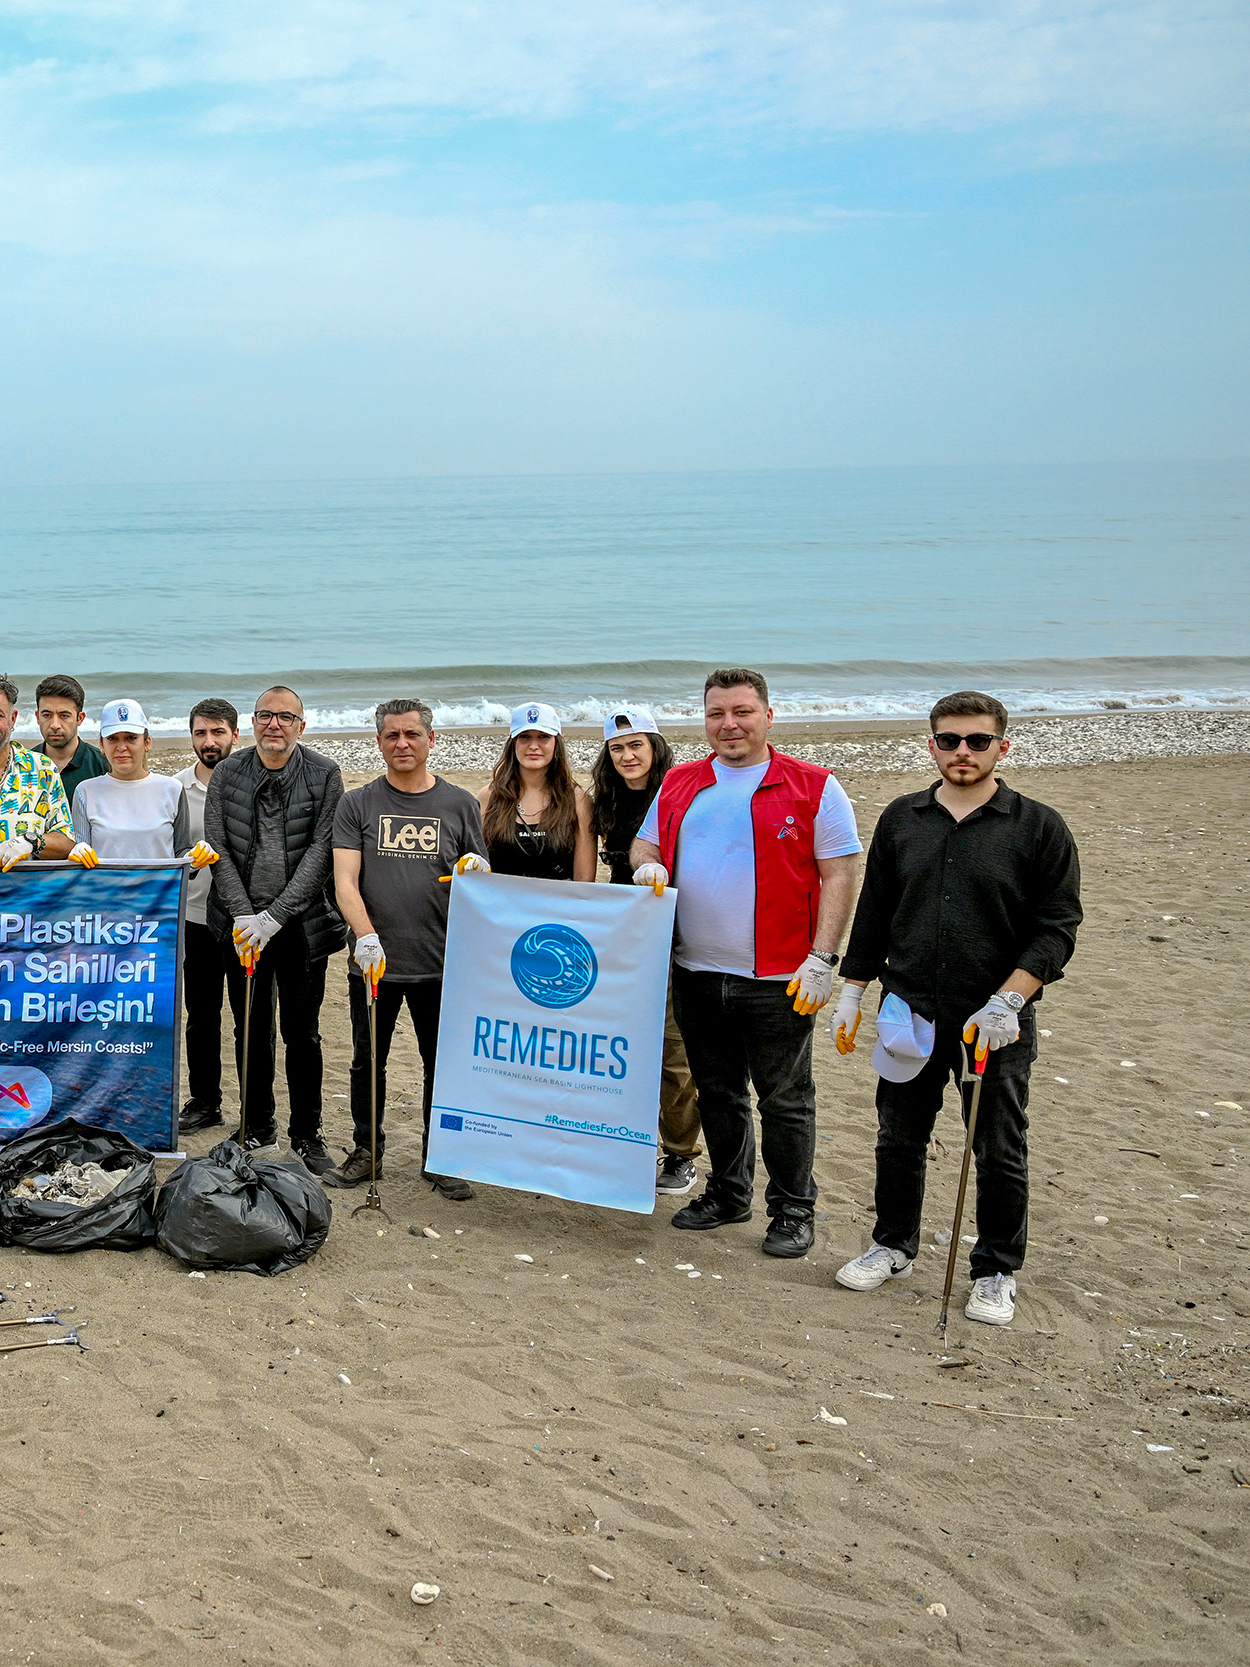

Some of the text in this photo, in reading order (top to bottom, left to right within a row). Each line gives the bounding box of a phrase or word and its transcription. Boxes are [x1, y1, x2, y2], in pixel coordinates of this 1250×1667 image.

[382, 817, 437, 851] Lee
[0, 913, 159, 945] Plastiksiz
[23, 952, 157, 984] Sahilleri
[21, 991, 155, 1031] Birleşin!
[47, 1040, 92, 1053] Mersin
[473, 1016, 628, 1080] REMEDIES
[472, 1066, 624, 1096] MEDITERRANEAN SEA BASIN LIGHTHOUSE
[544, 1114, 651, 1141] #RemediesForOcean
